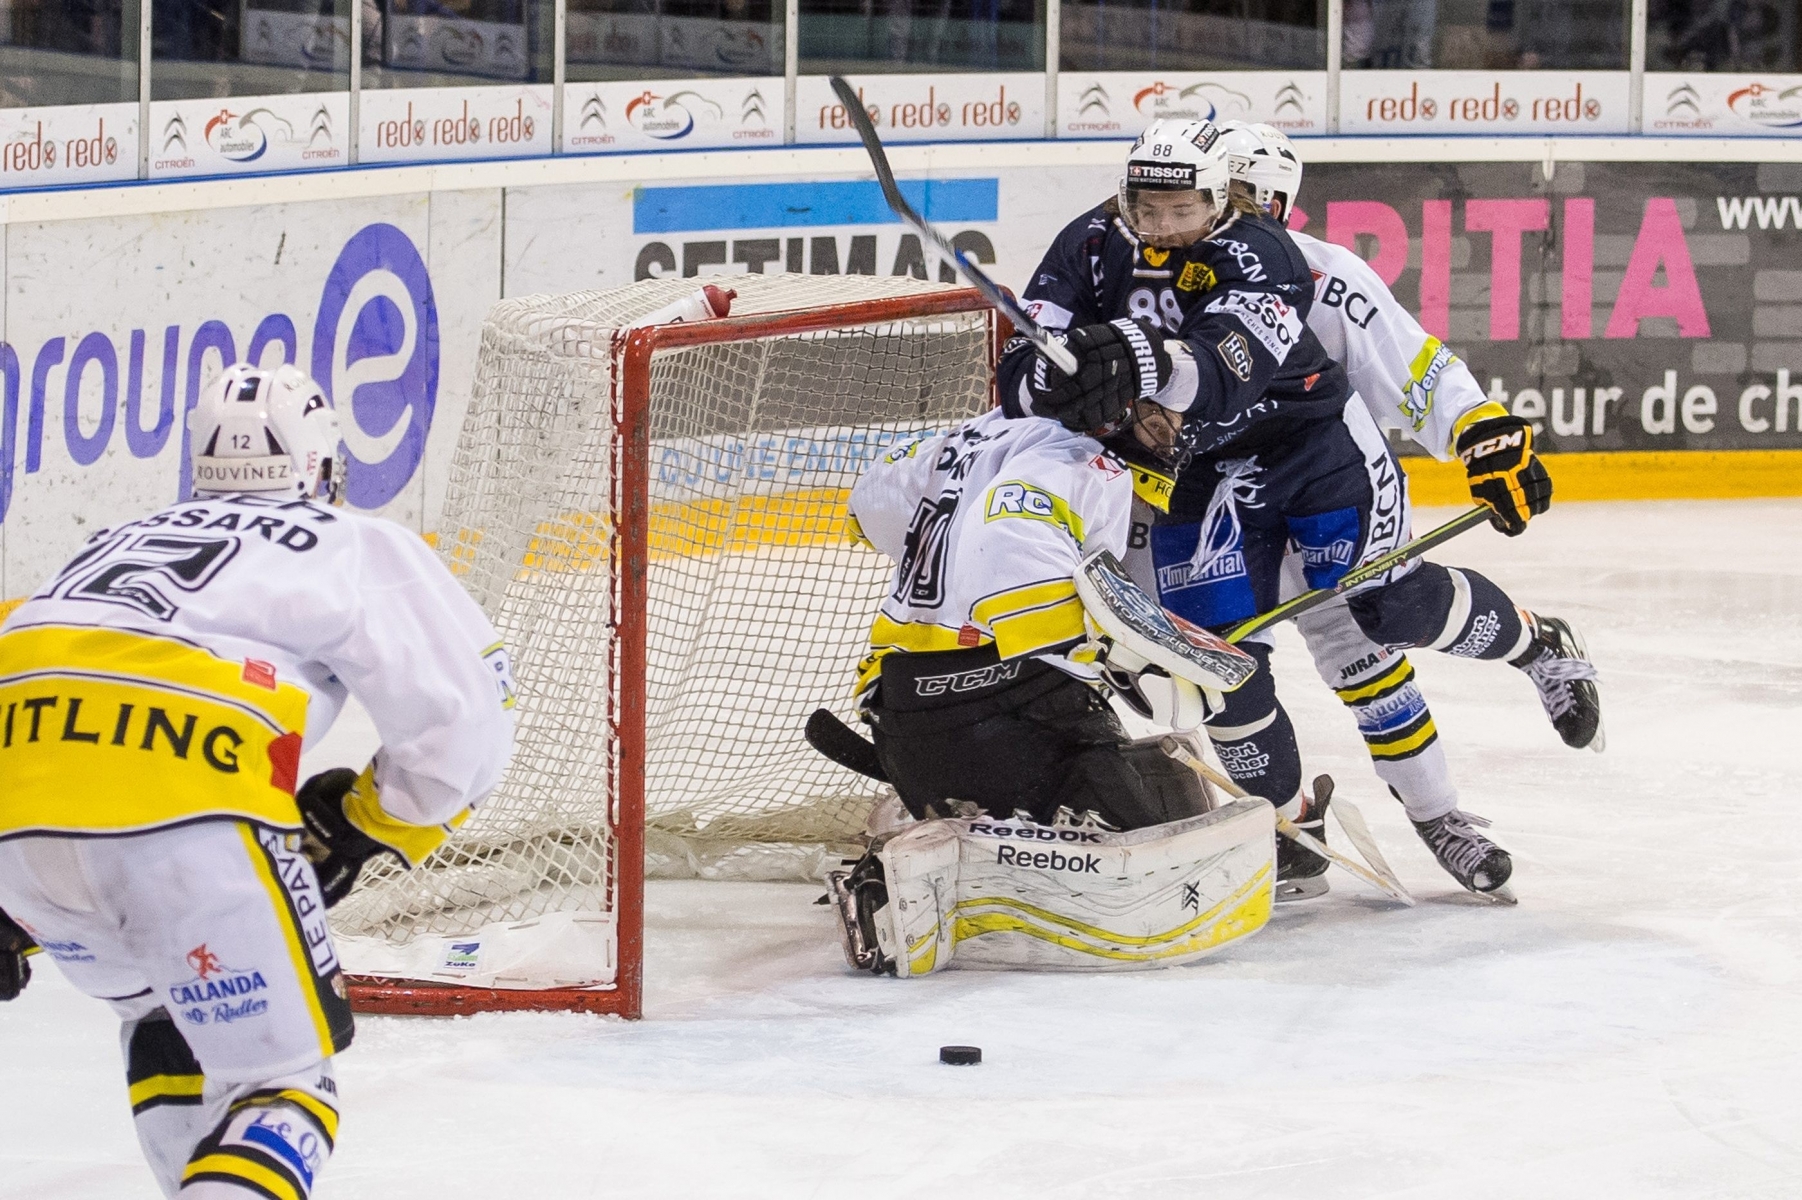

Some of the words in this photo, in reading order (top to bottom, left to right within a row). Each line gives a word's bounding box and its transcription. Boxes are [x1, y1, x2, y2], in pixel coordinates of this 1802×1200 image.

[1152, 144, 1173, 157] 88
[1142, 166, 1192, 179] TISSOT
[1227, 238, 1268, 283] BCN
[1290, 197, 1712, 341] PITIA
[1130, 286, 1185, 334] 88
[1109, 317, 1158, 399] WARRIOR
[1225, 335, 1250, 379] HCC
[1640, 369, 1718, 435] de
[232, 434, 251, 449] 12
[1370, 452, 1399, 545] BCN
[914, 660, 1022, 697] CCM
[1340, 652, 1380, 680] JURA
[0, 695, 244, 774] ITLING
[968, 822, 1102, 844] Reebok
[996, 844, 1102, 875] Reebok
[169, 971, 267, 1005] CALANDA
